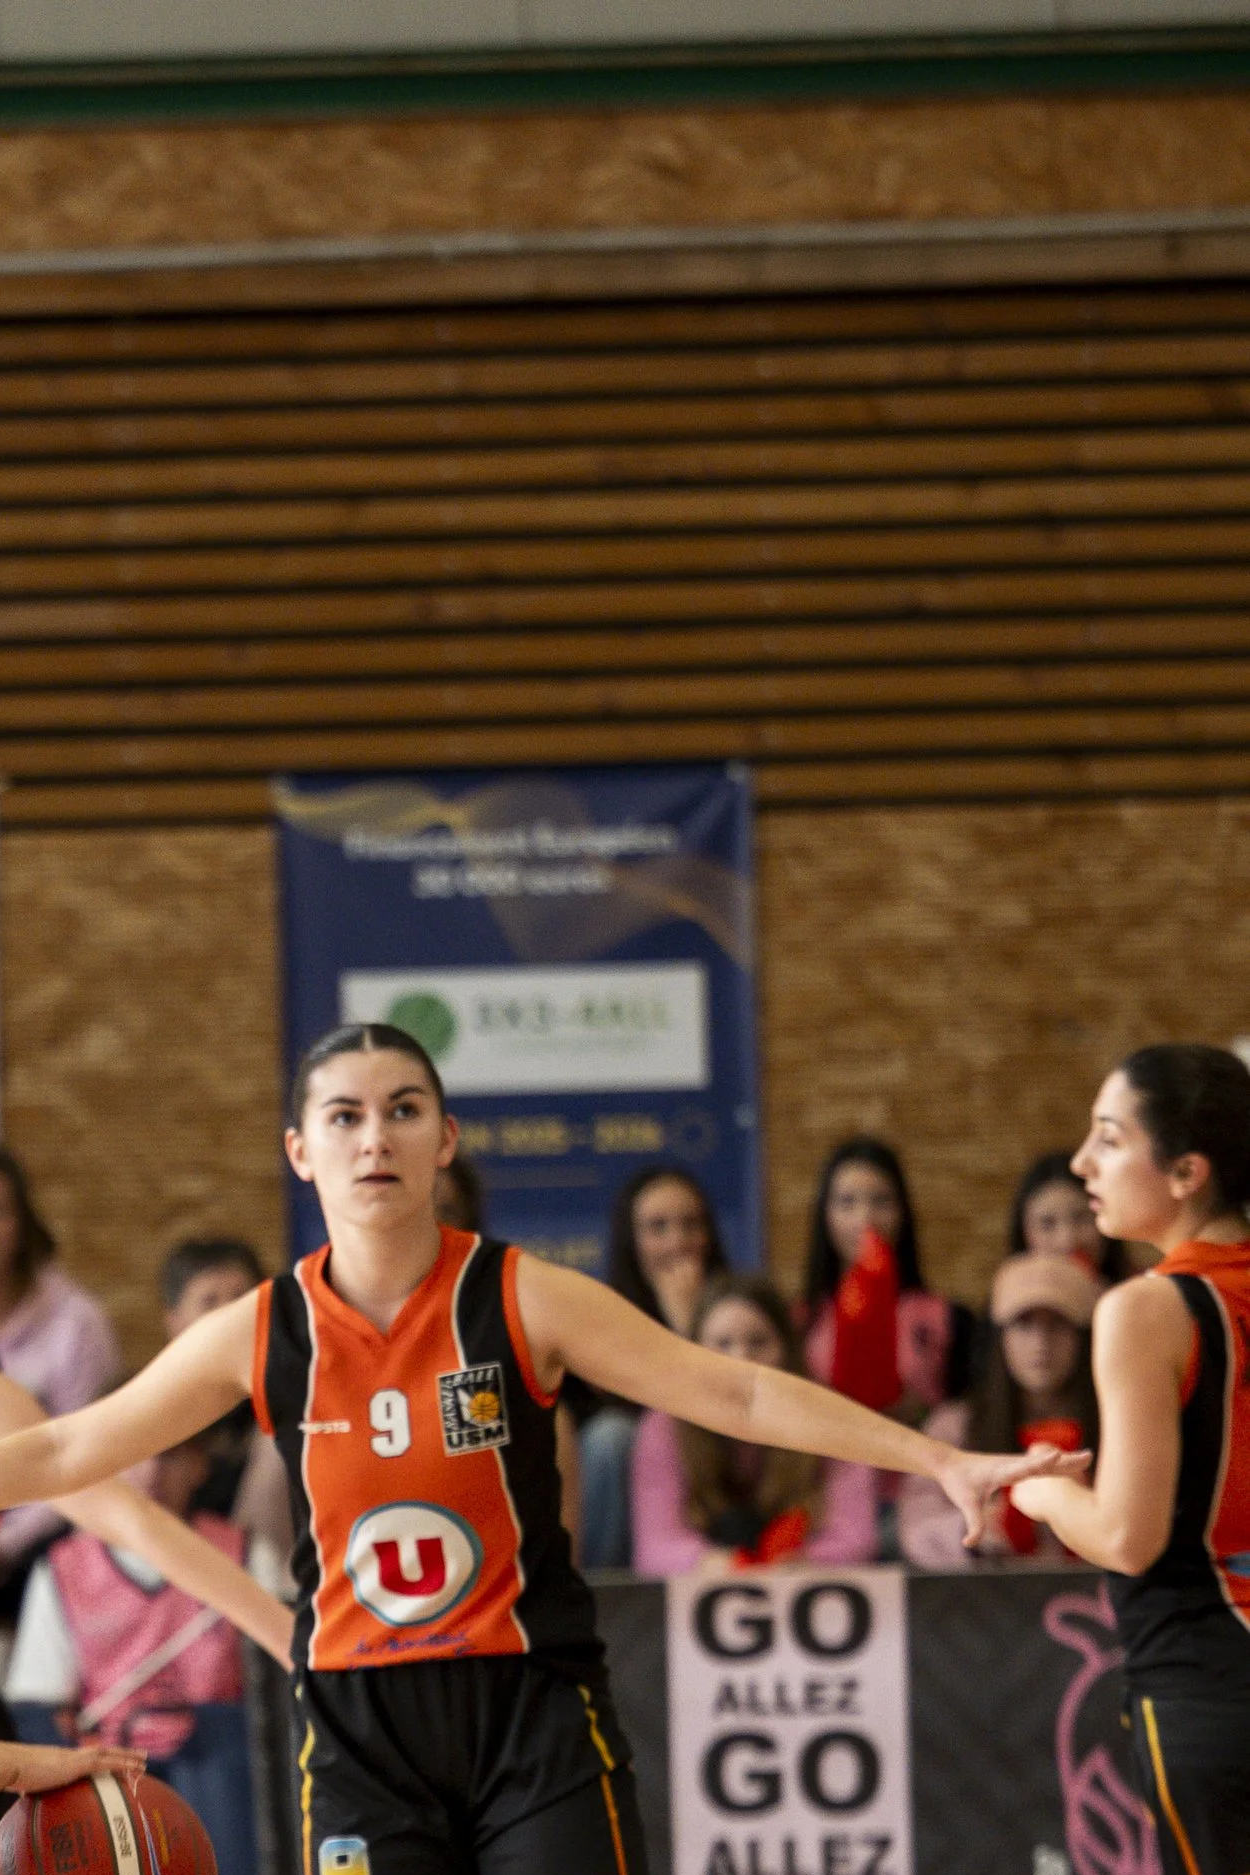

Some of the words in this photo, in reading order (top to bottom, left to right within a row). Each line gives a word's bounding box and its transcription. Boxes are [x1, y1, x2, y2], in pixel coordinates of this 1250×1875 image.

[369, 1388, 411, 1458] 9
[447, 1425, 505, 1448] USM
[372, 1537, 445, 1596] U
[694, 1583, 872, 1661] GO
[716, 1674, 860, 1717] ALLEZ
[703, 1732, 880, 1817] GO
